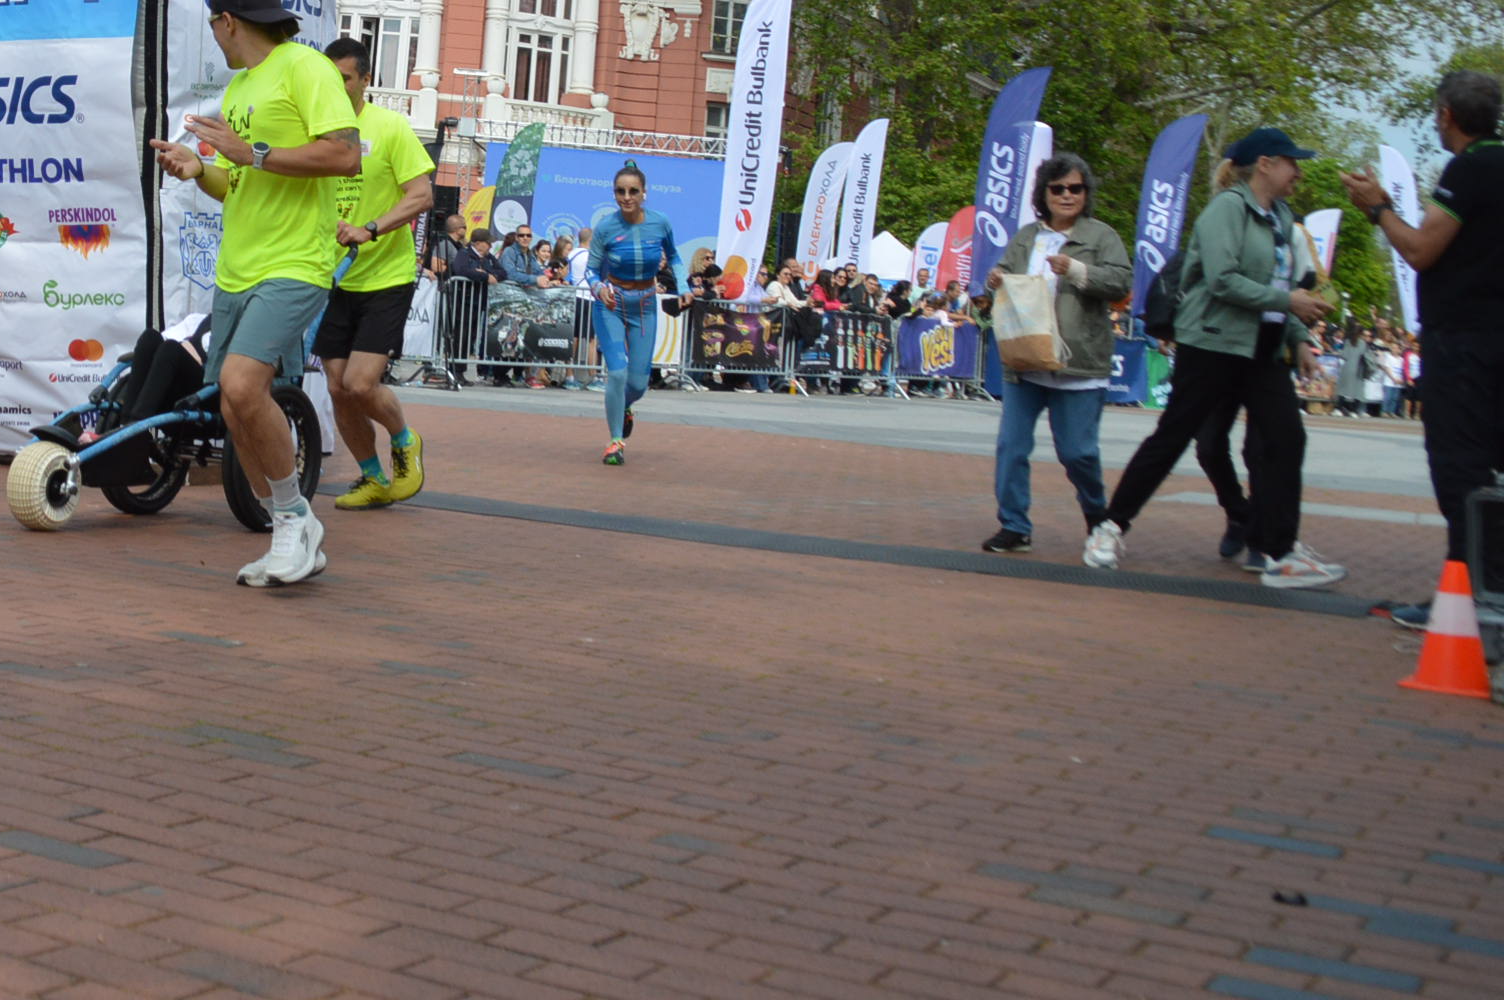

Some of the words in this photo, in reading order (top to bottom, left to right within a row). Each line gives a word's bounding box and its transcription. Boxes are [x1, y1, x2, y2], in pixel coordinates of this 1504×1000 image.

[746, 20, 773, 106] Bulbank
[738, 111, 763, 206] UniCredit
[854, 153, 872, 206] Bulbank
[48, 208, 117, 223] PERSKINDOL
[415, 212, 427, 254] NATURAL
[808, 159, 837, 257] ЕЛЕКТРОХОЛД
[847, 208, 864, 265] UniCredit
[57, 373, 91, 383] UniCredit
